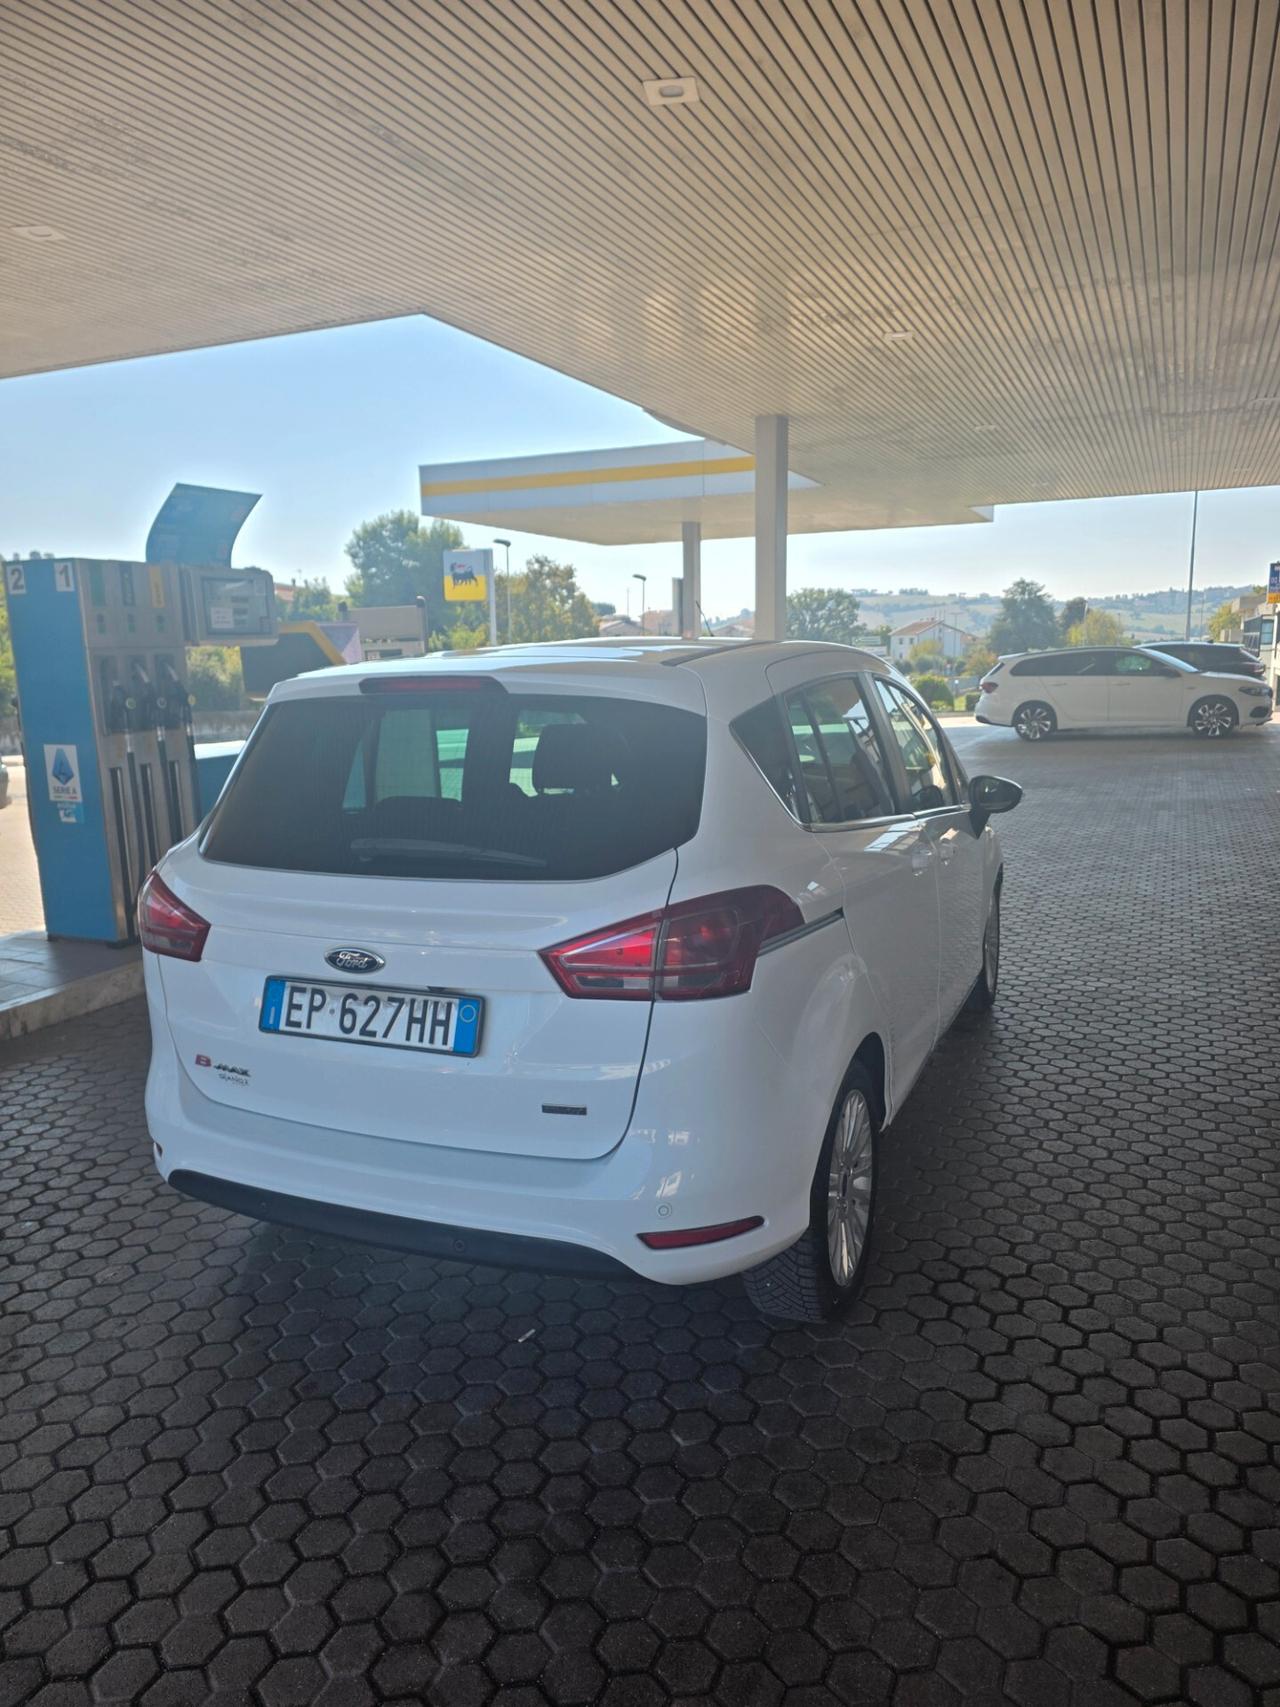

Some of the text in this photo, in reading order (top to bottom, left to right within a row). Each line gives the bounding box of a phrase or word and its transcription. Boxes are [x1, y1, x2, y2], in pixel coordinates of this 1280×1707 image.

[10, 568, 24, 591] 2
[59, 565, 71, 588] 1
[336, 951, 369, 969] Ford
